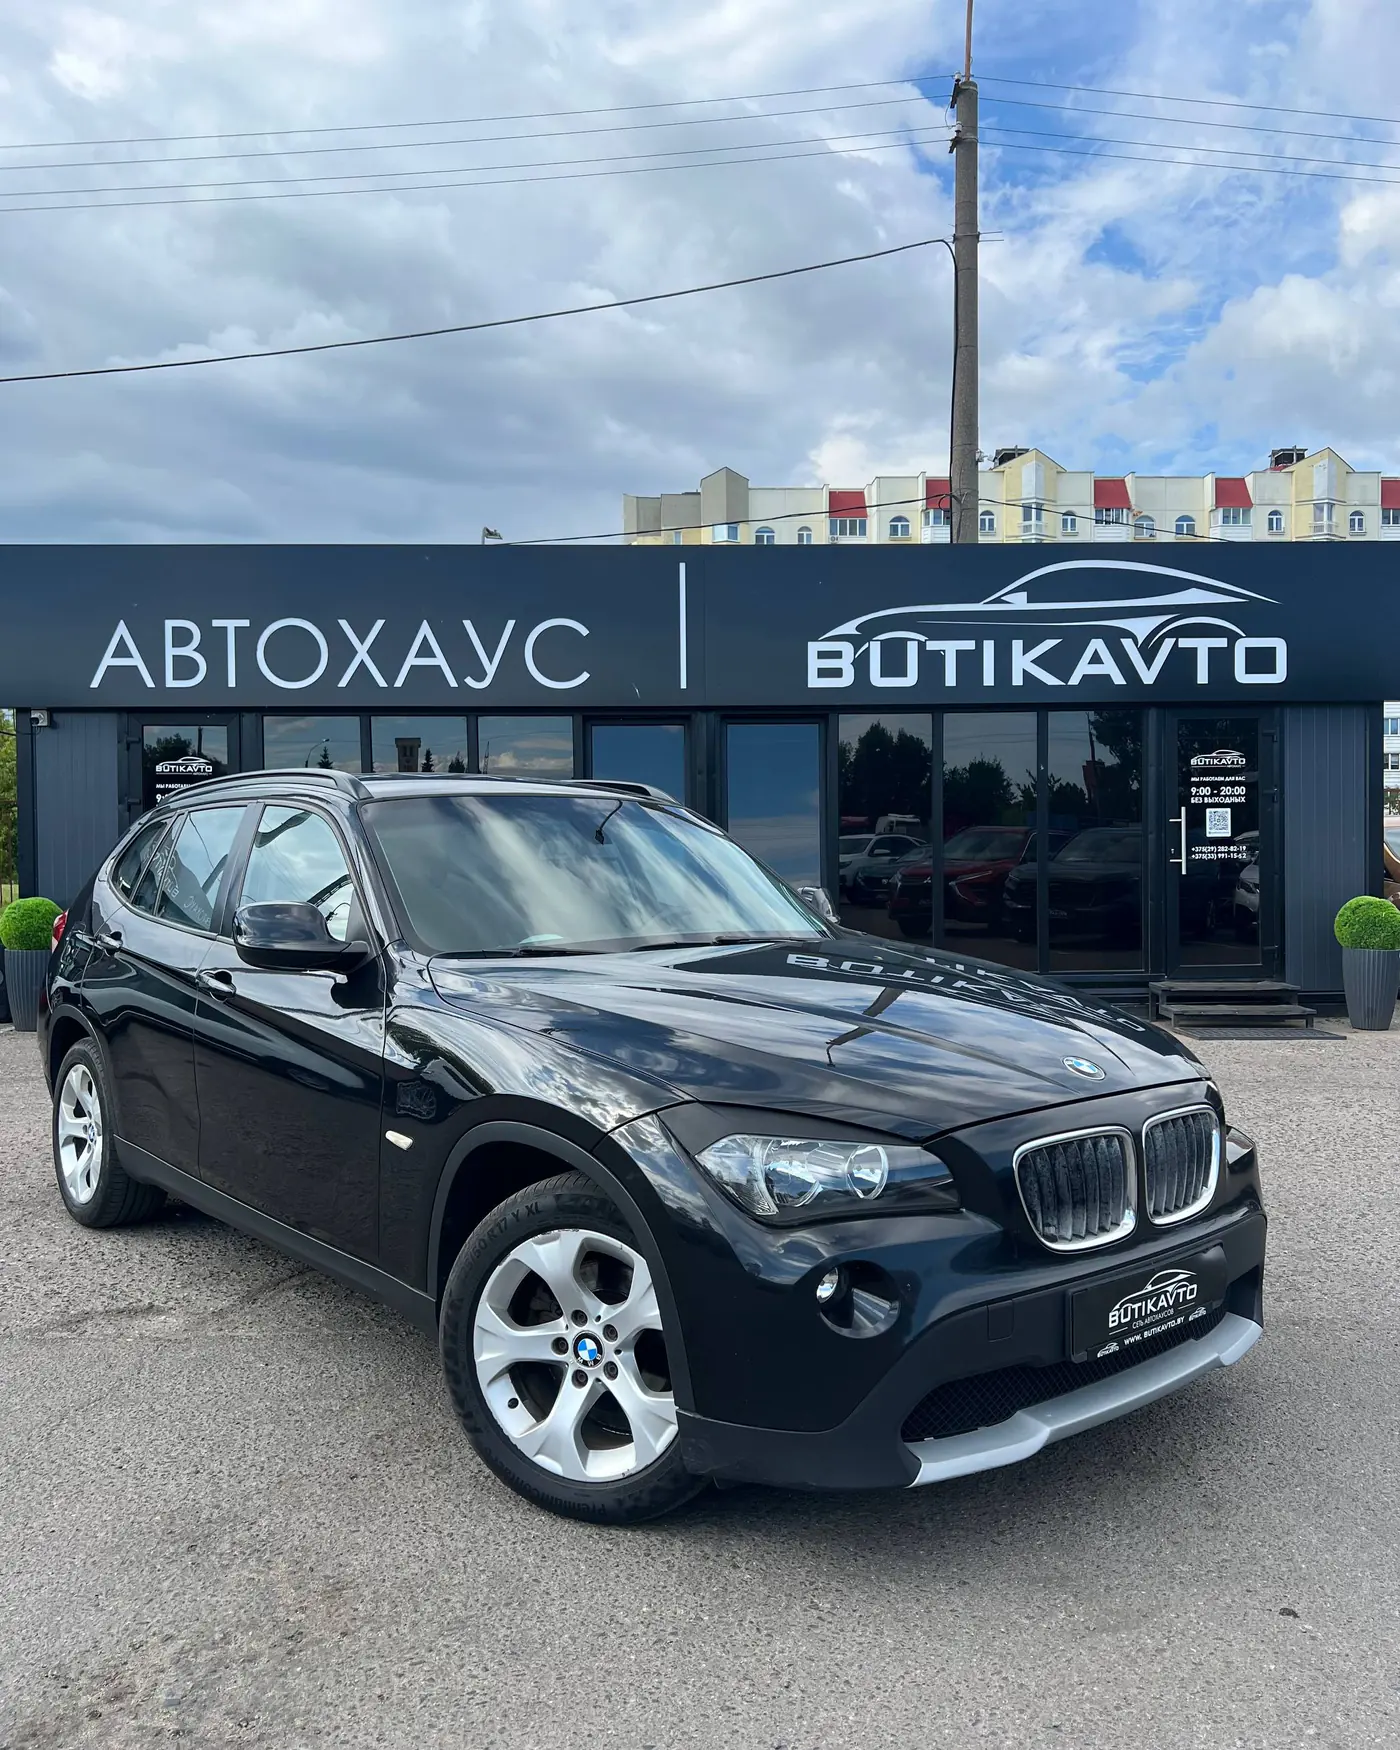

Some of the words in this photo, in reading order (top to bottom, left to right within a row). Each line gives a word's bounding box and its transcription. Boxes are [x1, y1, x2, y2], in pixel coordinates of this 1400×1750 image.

[90, 617, 591, 690] АВТОХАУС
[806, 636, 1288, 688] BUTIKAVTO
[155, 764, 213, 772] BUTIKAVTO
[1190, 757, 1246, 766] BUTIKAVTO
[1190, 787, 1211, 796] 9:00
[1220, 786, 1246, 795] 20:00
[525, 1201, 543, 1218] XL
[1108, 1283, 1198, 1329] BUTIKAVTO
[1145, 1308, 1175, 1326] АВТОХАУСОВ
[1143, 1315, 1186, 1338] BUTIKAVTO.BY
